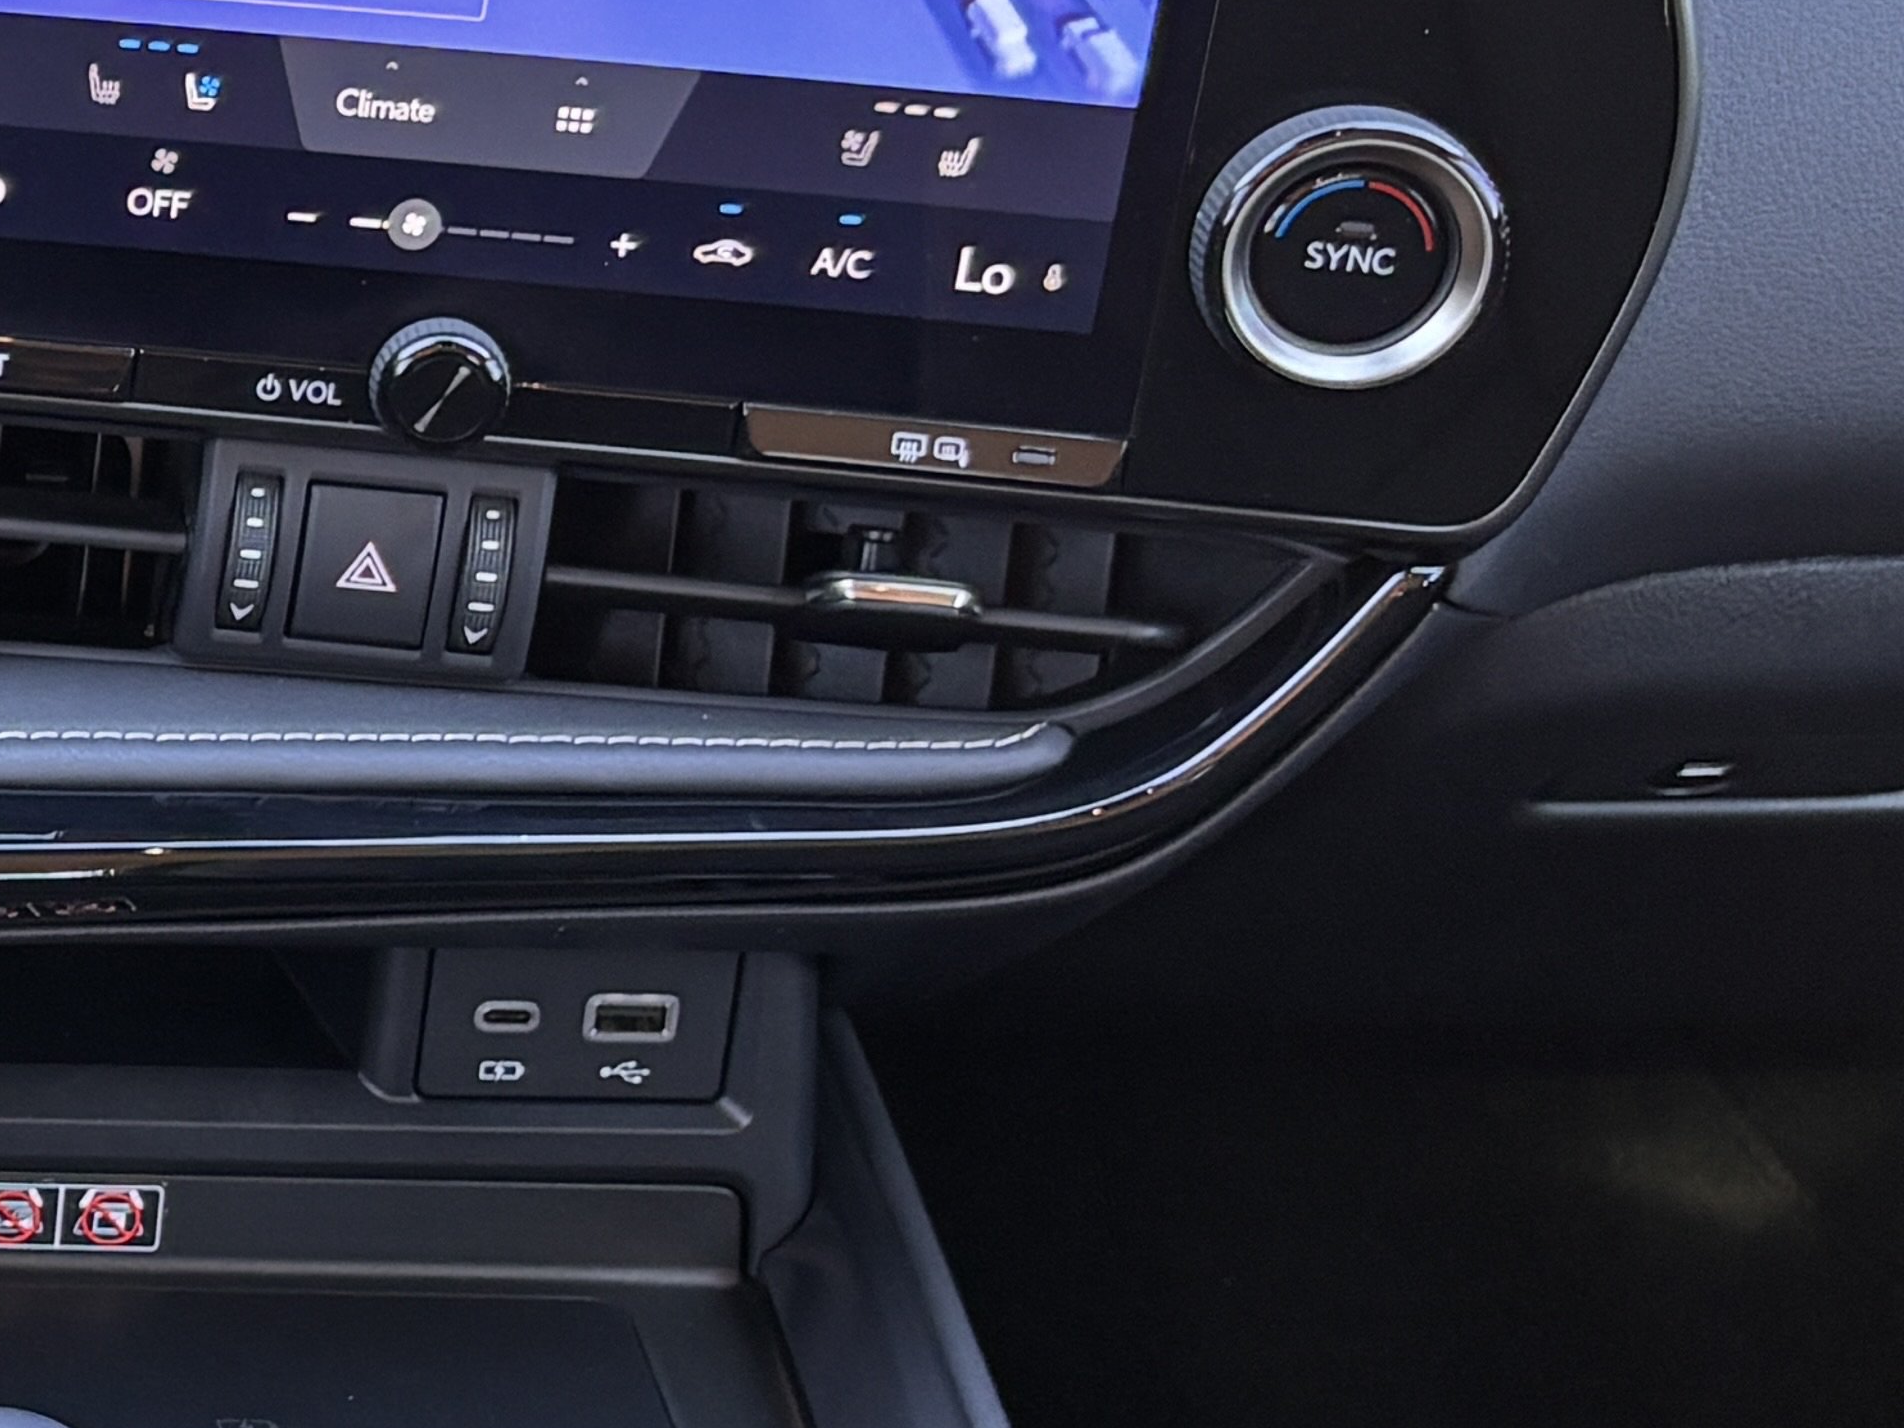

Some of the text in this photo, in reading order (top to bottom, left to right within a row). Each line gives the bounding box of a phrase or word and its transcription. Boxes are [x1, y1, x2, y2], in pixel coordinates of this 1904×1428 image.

[335, 87, 436, 124] Climate
[127, 188, 193, 220] OFF
[811, 247, 874, 281] A/C
[954, 246, 1015, 295] Lo
[1304, 240, 1396, 276] SYNC
[289, 379, 342, 407] VOL
